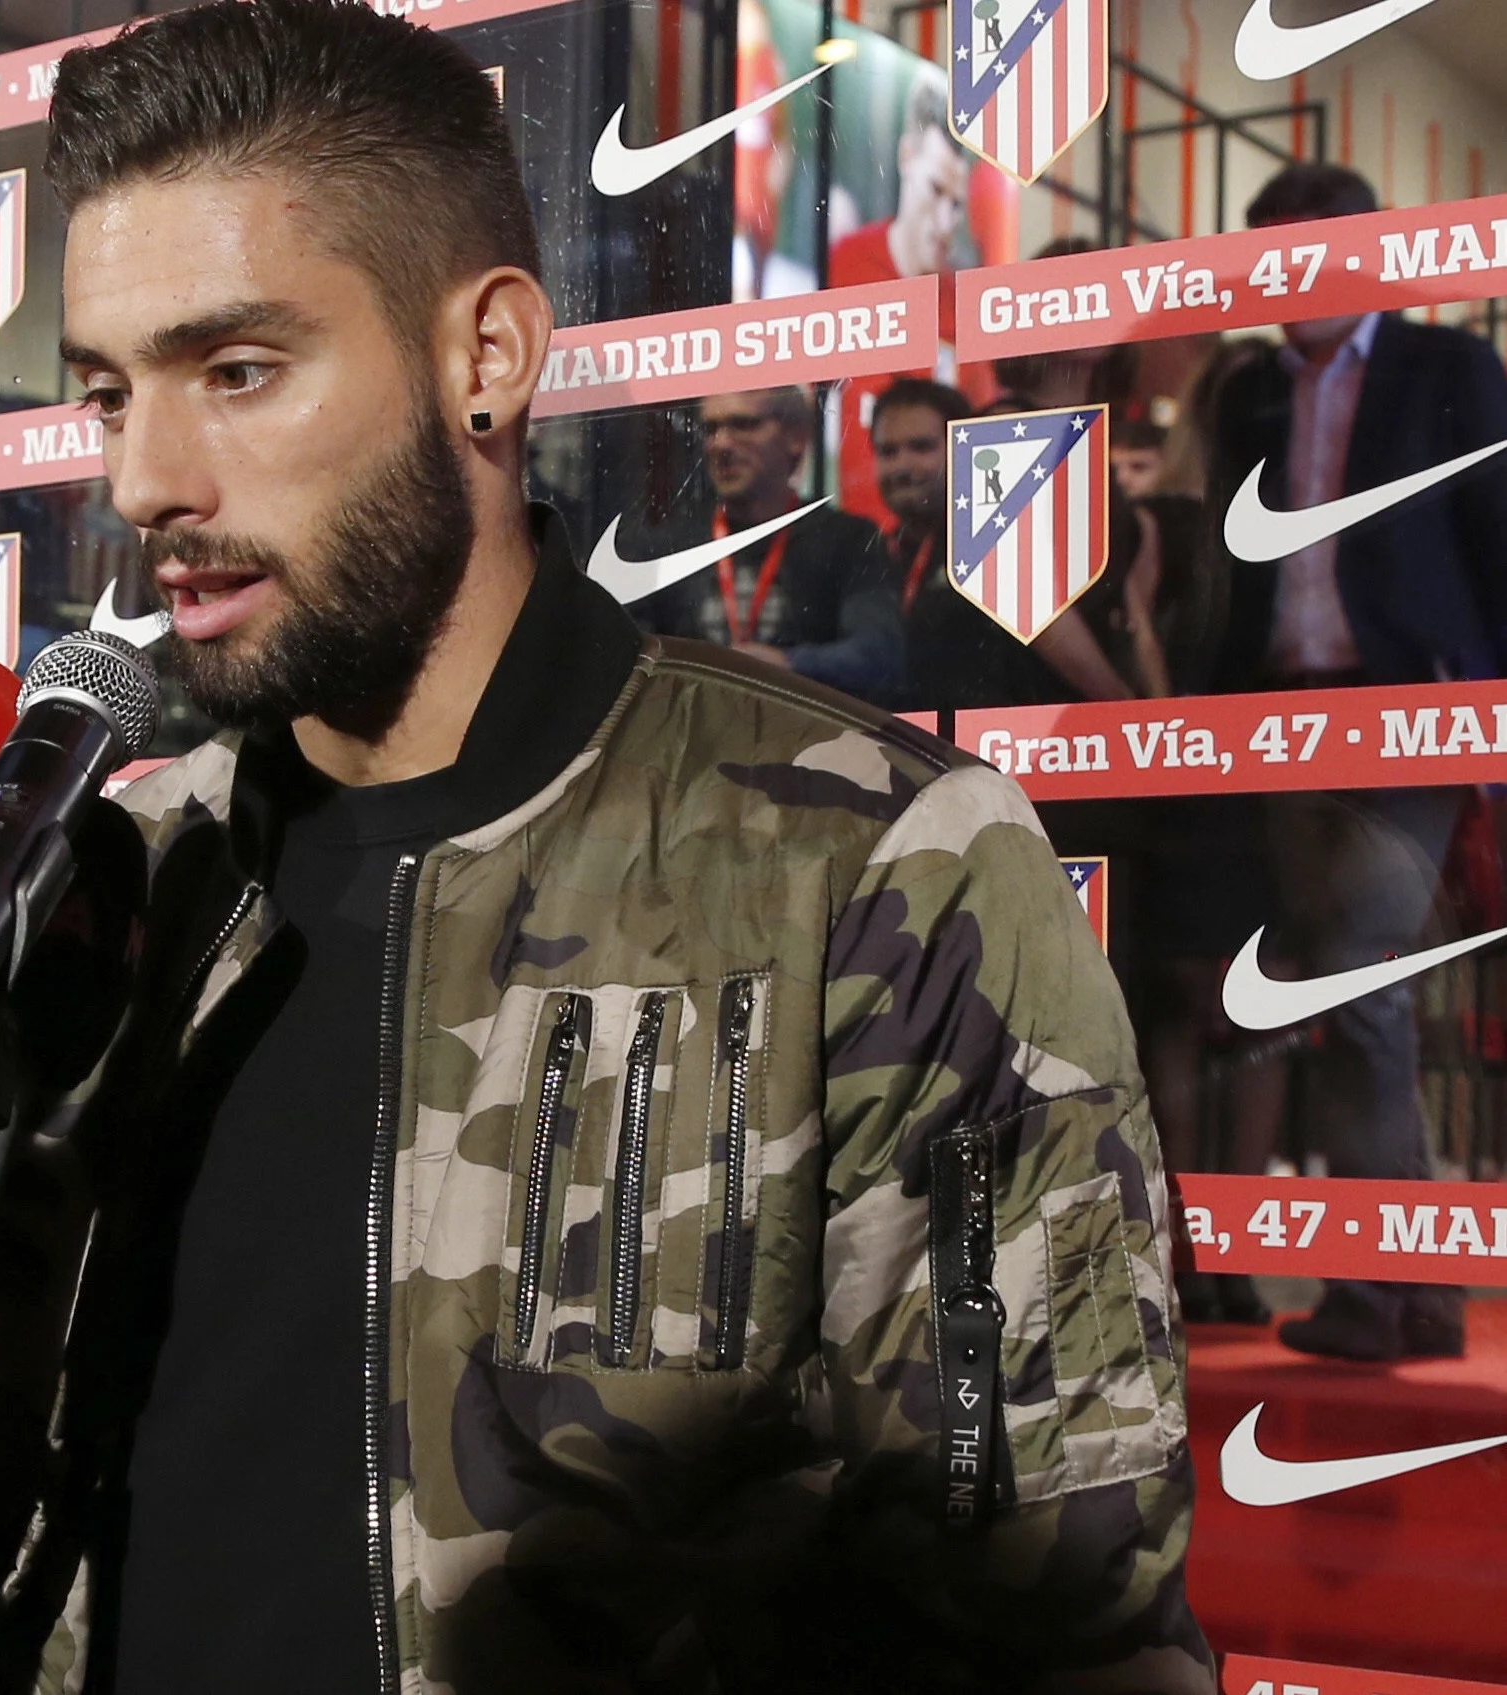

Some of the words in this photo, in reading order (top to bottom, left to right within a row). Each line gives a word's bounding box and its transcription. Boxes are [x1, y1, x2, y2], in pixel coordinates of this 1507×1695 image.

[979, 281, 1111, 334] Gran
[1121, 259, 1234, 313] Vía,
[1248, 242, 1328, 298] 47
[532, 326, 722, 394] MADRID
[734, 300, 908, 369] STORE
[978, 729, 1111, 776] Gran
[1121, 718, 1234, 776] Vía,
[1248, 713, 1329, 764] 47
[1246, 1198, 1328, 1250] 47
[950, 1425, 980, 1476] THE
